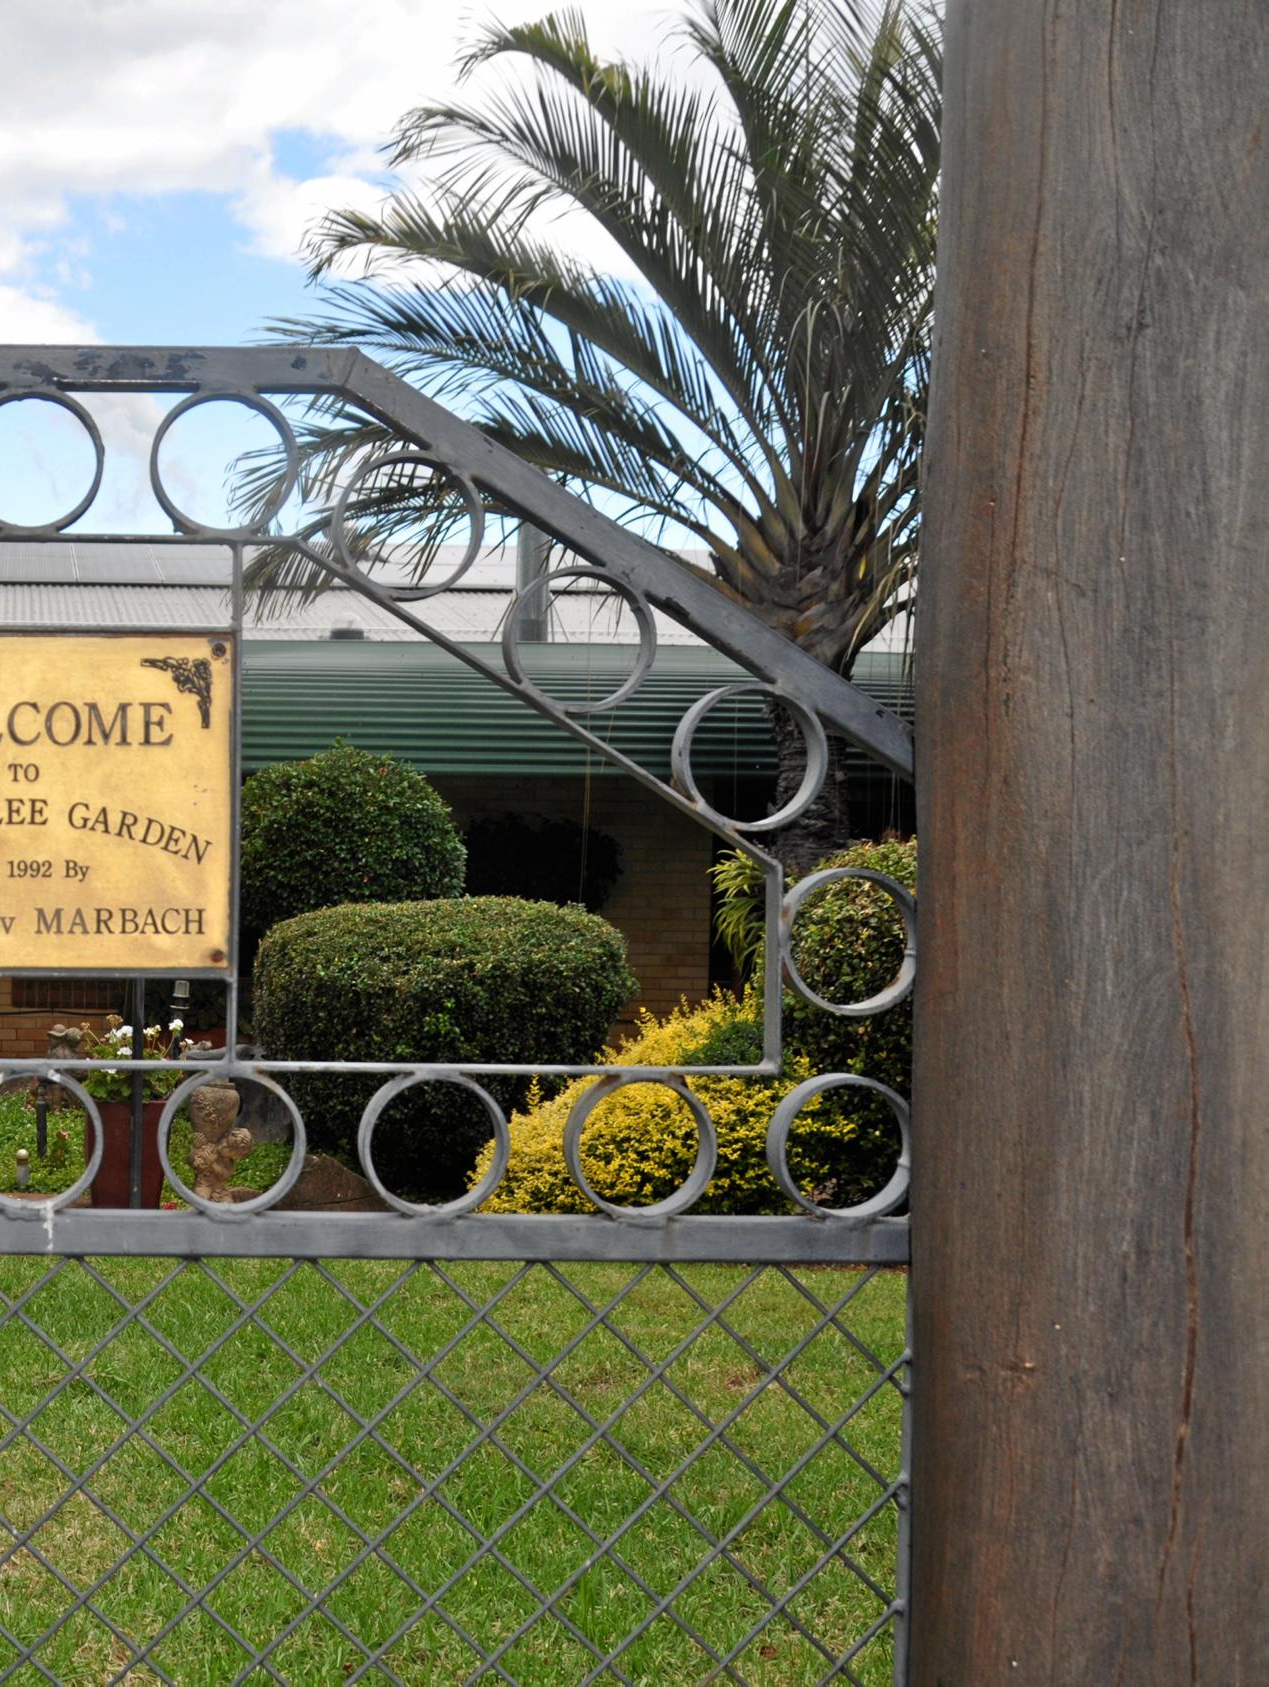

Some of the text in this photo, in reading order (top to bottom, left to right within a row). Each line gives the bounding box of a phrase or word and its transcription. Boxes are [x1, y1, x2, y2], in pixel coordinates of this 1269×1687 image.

[8, 763, 39, 782] TO
[68, 802, 212, 865] GARDEN
[8, 860, 52, 878] 1992
[64, 860, 90, 882] By
[35, 908, 206, 935] MARBACH
